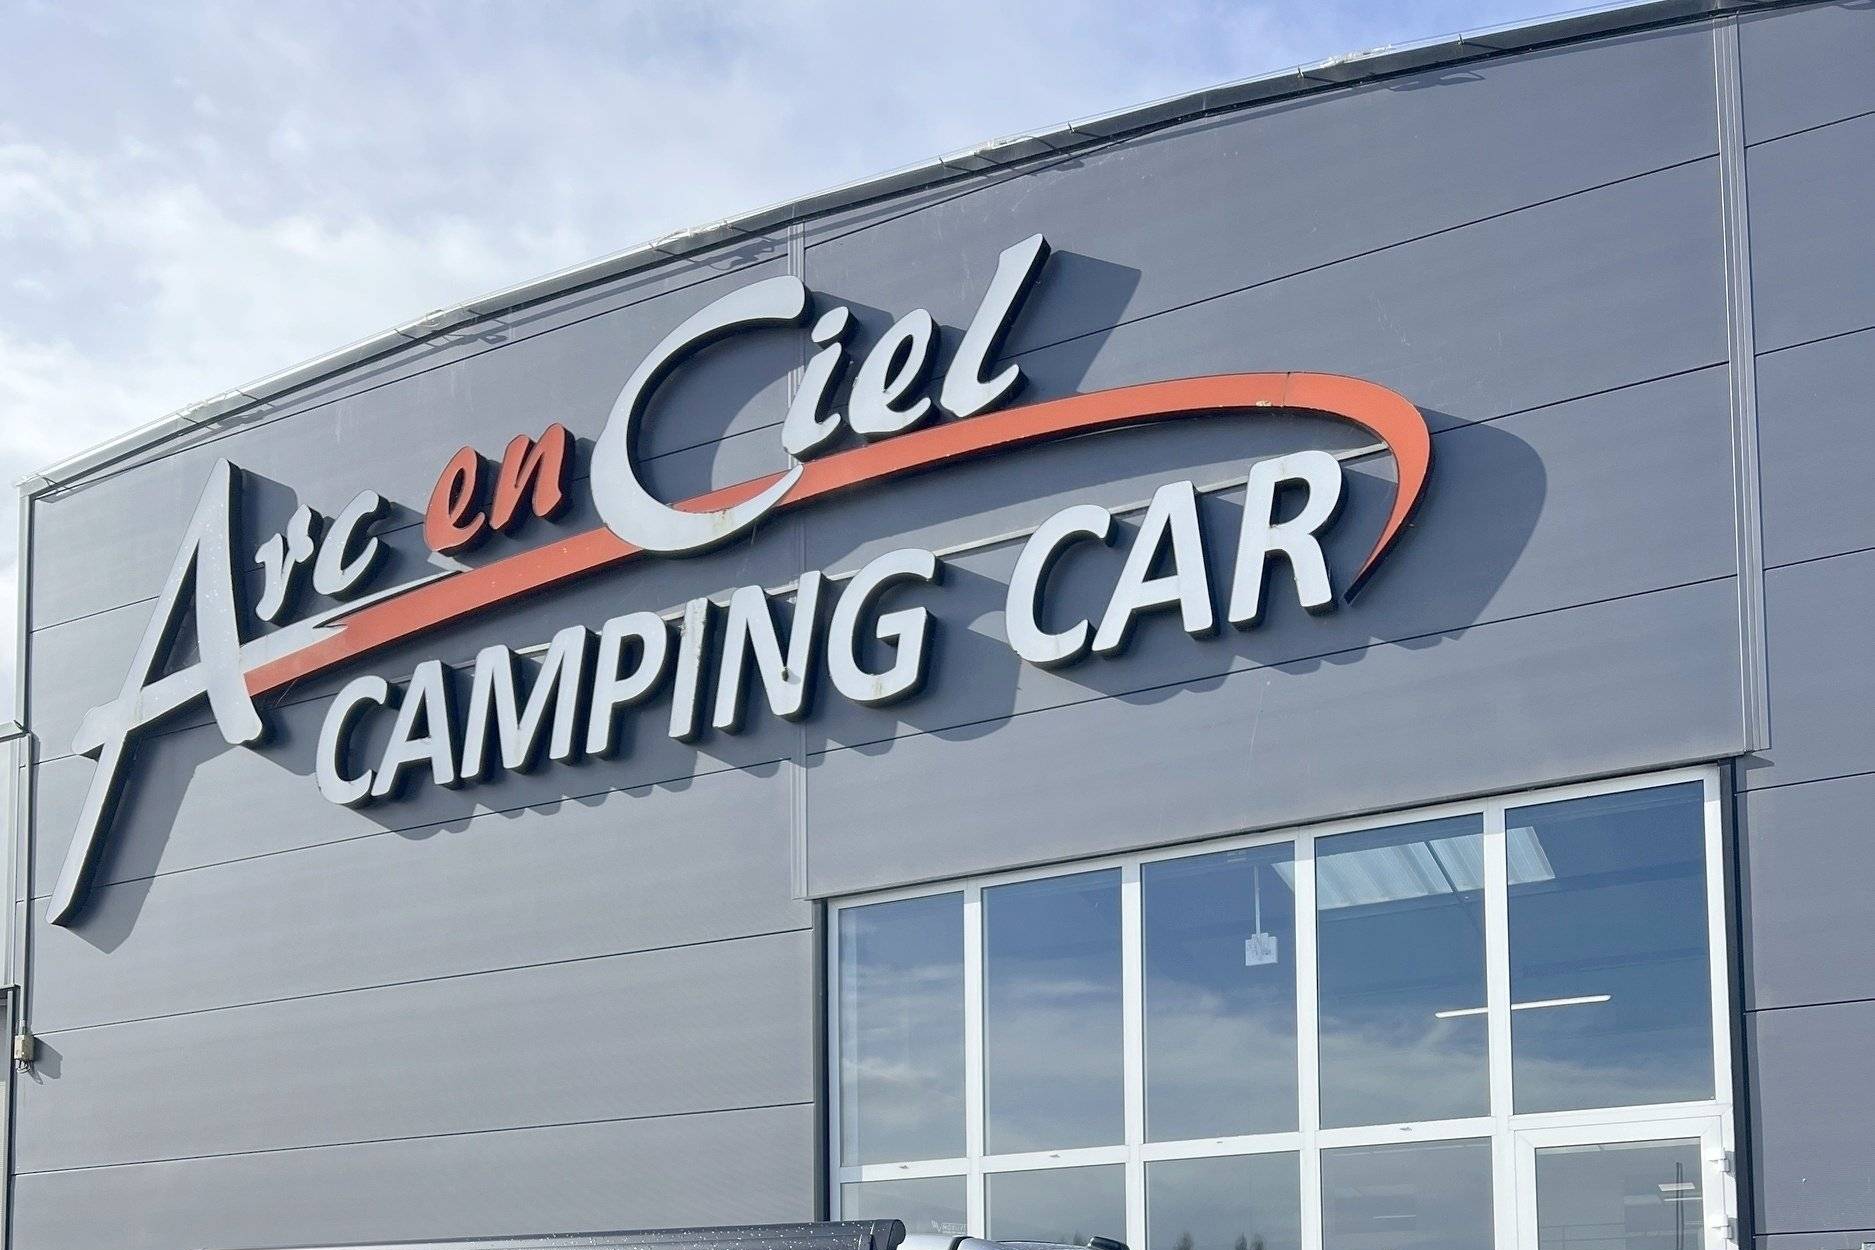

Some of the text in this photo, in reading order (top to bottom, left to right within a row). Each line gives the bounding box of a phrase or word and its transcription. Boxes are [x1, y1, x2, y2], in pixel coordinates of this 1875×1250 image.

[46, 232, 1052, 926] Arc en Ciel
[315, 449, 1344, 806] CAMPING CAR
